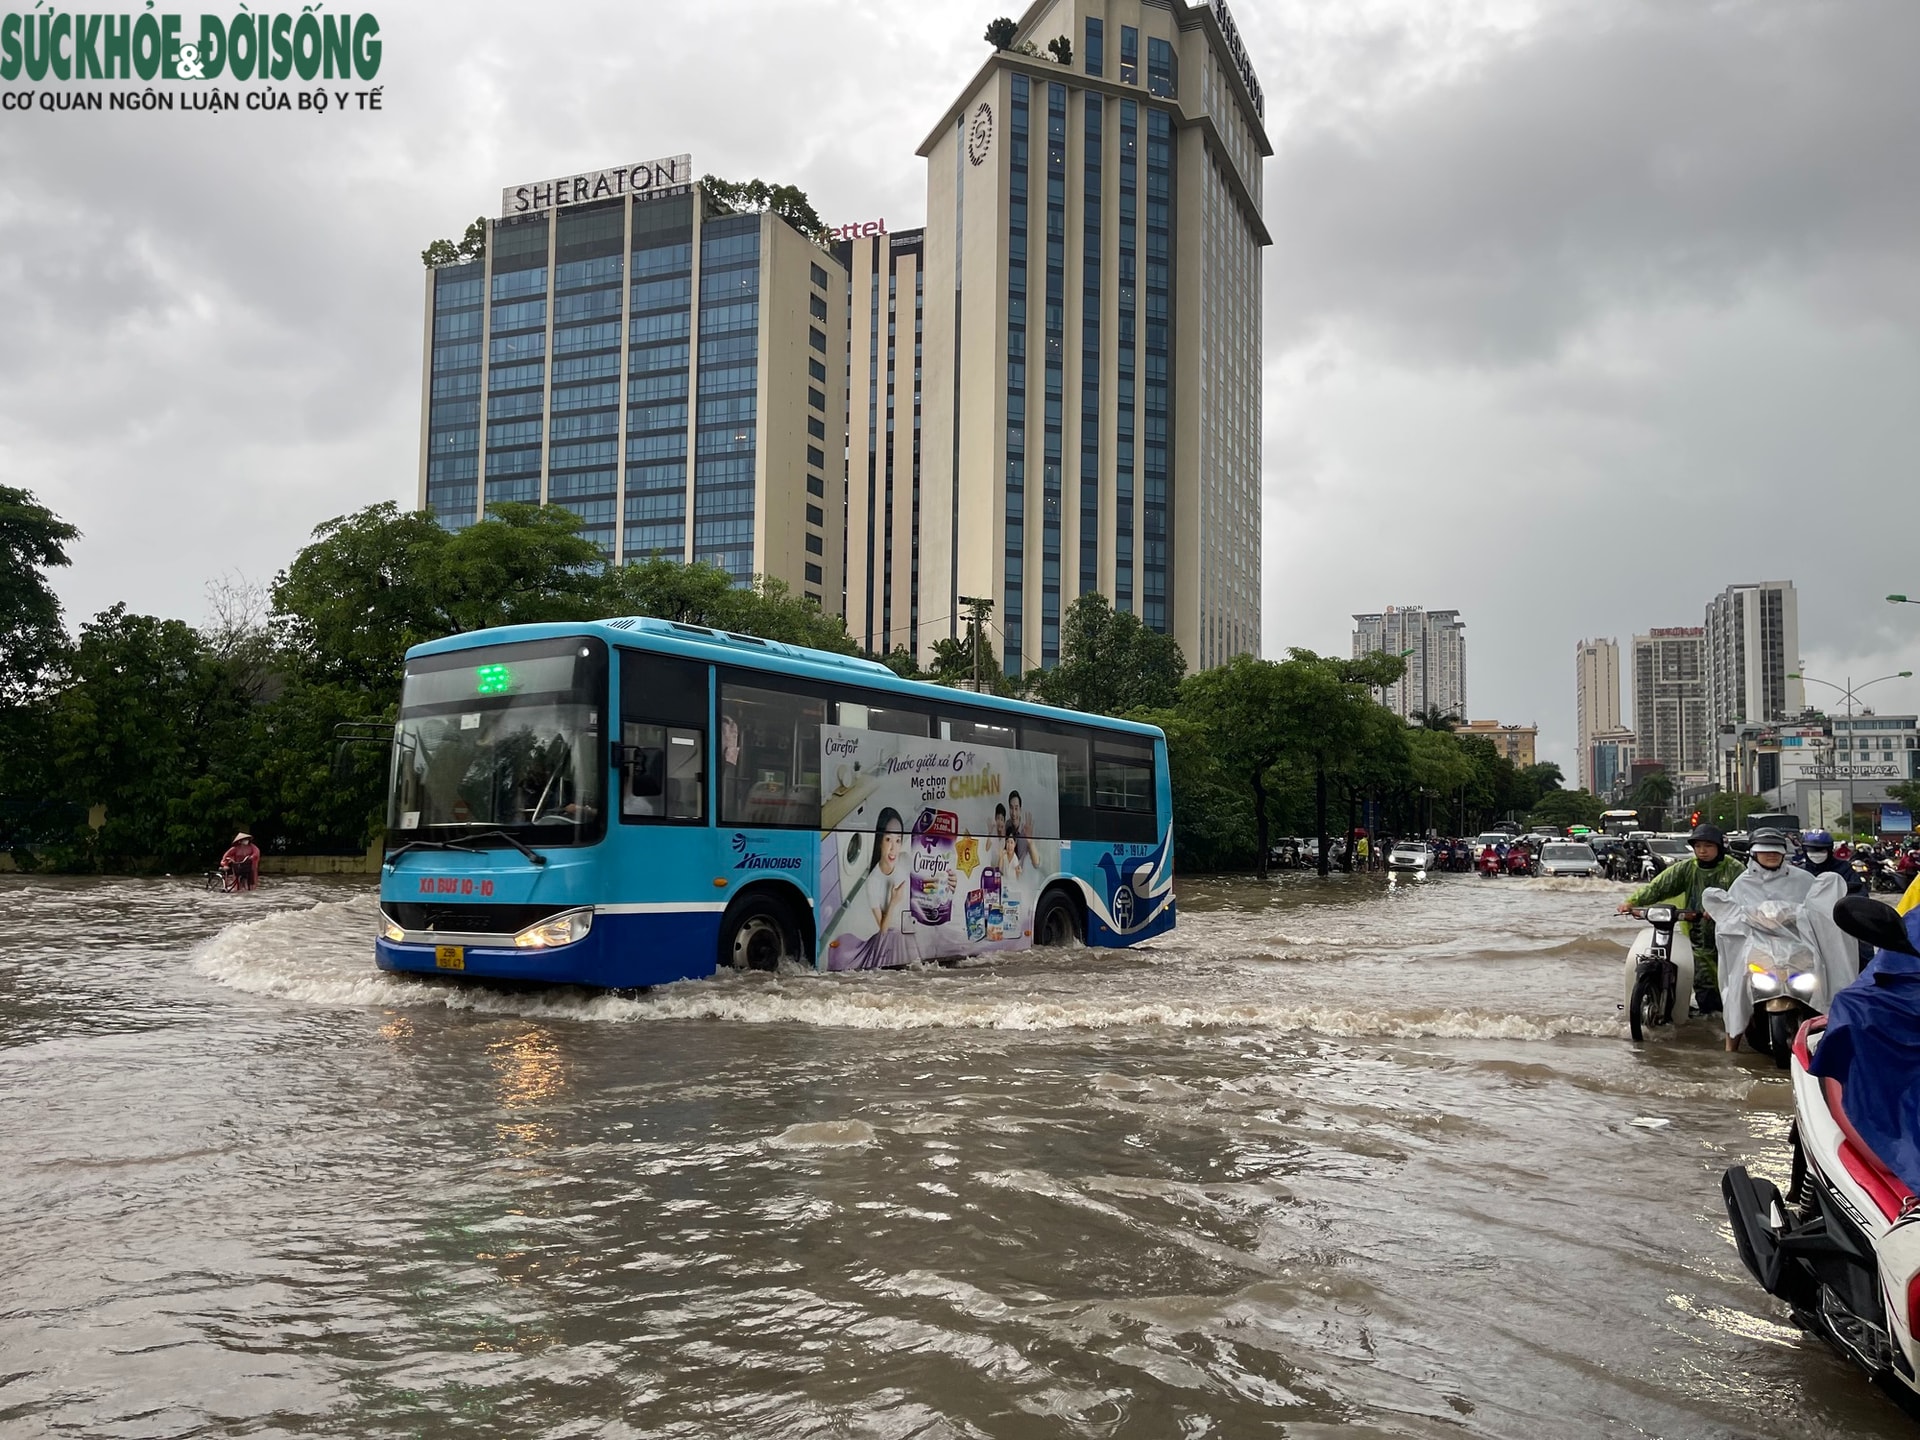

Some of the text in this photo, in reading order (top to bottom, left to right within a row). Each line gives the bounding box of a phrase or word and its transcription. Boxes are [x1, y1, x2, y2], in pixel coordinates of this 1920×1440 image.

[515, 159, 677, 212] SHERATON
[829, 218, 888, 240] ettel
[825, 738, 858, 758] Carefor
[887, 755, 915, 775] Nước
[916, 753, 937, 773] giặt
[953, 750, 966, 771] 6
[1800, 766, 1833, 775] THIEN
[1860, 765, 1900, 775] PLAZA
[911, 775, 947, 791] Mẹ chọn
[949, 762, 1000, 799] CHUẨN
[921, 787, 946, 801] chỉ có
[734, 853, 802, 869] HANOIBUS
[913, 851, 949, 877] Carefor
[437, 877, 458, 893] BUS
